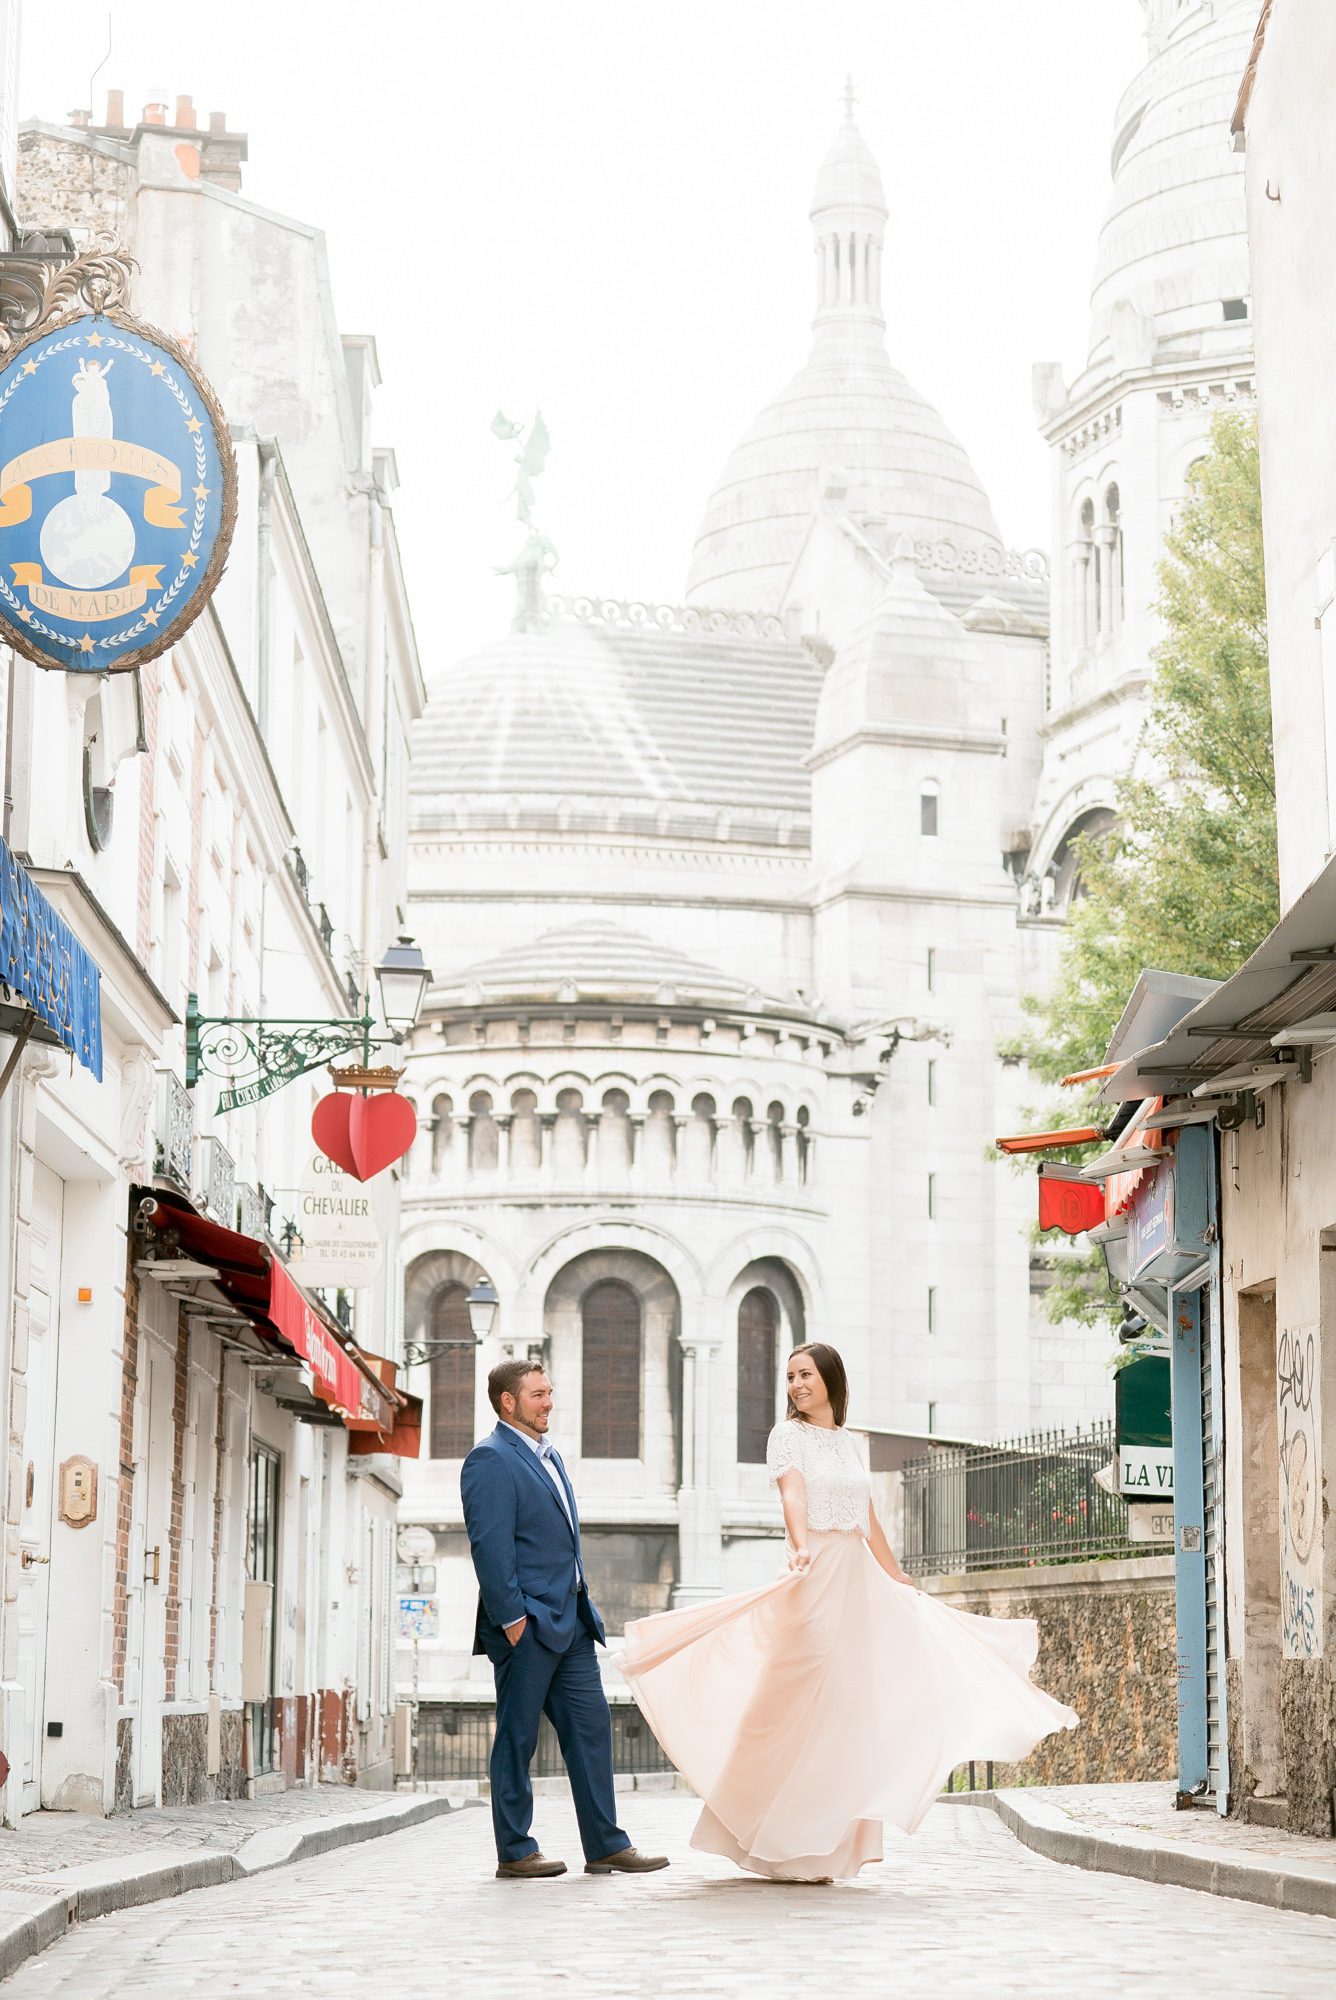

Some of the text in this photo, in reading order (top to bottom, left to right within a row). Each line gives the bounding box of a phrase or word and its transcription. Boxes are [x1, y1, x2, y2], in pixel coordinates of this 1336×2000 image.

[34, 586, 138, 616] DE MARIE
[331, 1180, 343, 1191] DU
[303, 1196, 368, 1216] CHEVALIER
[1124, 1463, 1150, 1486] LA
